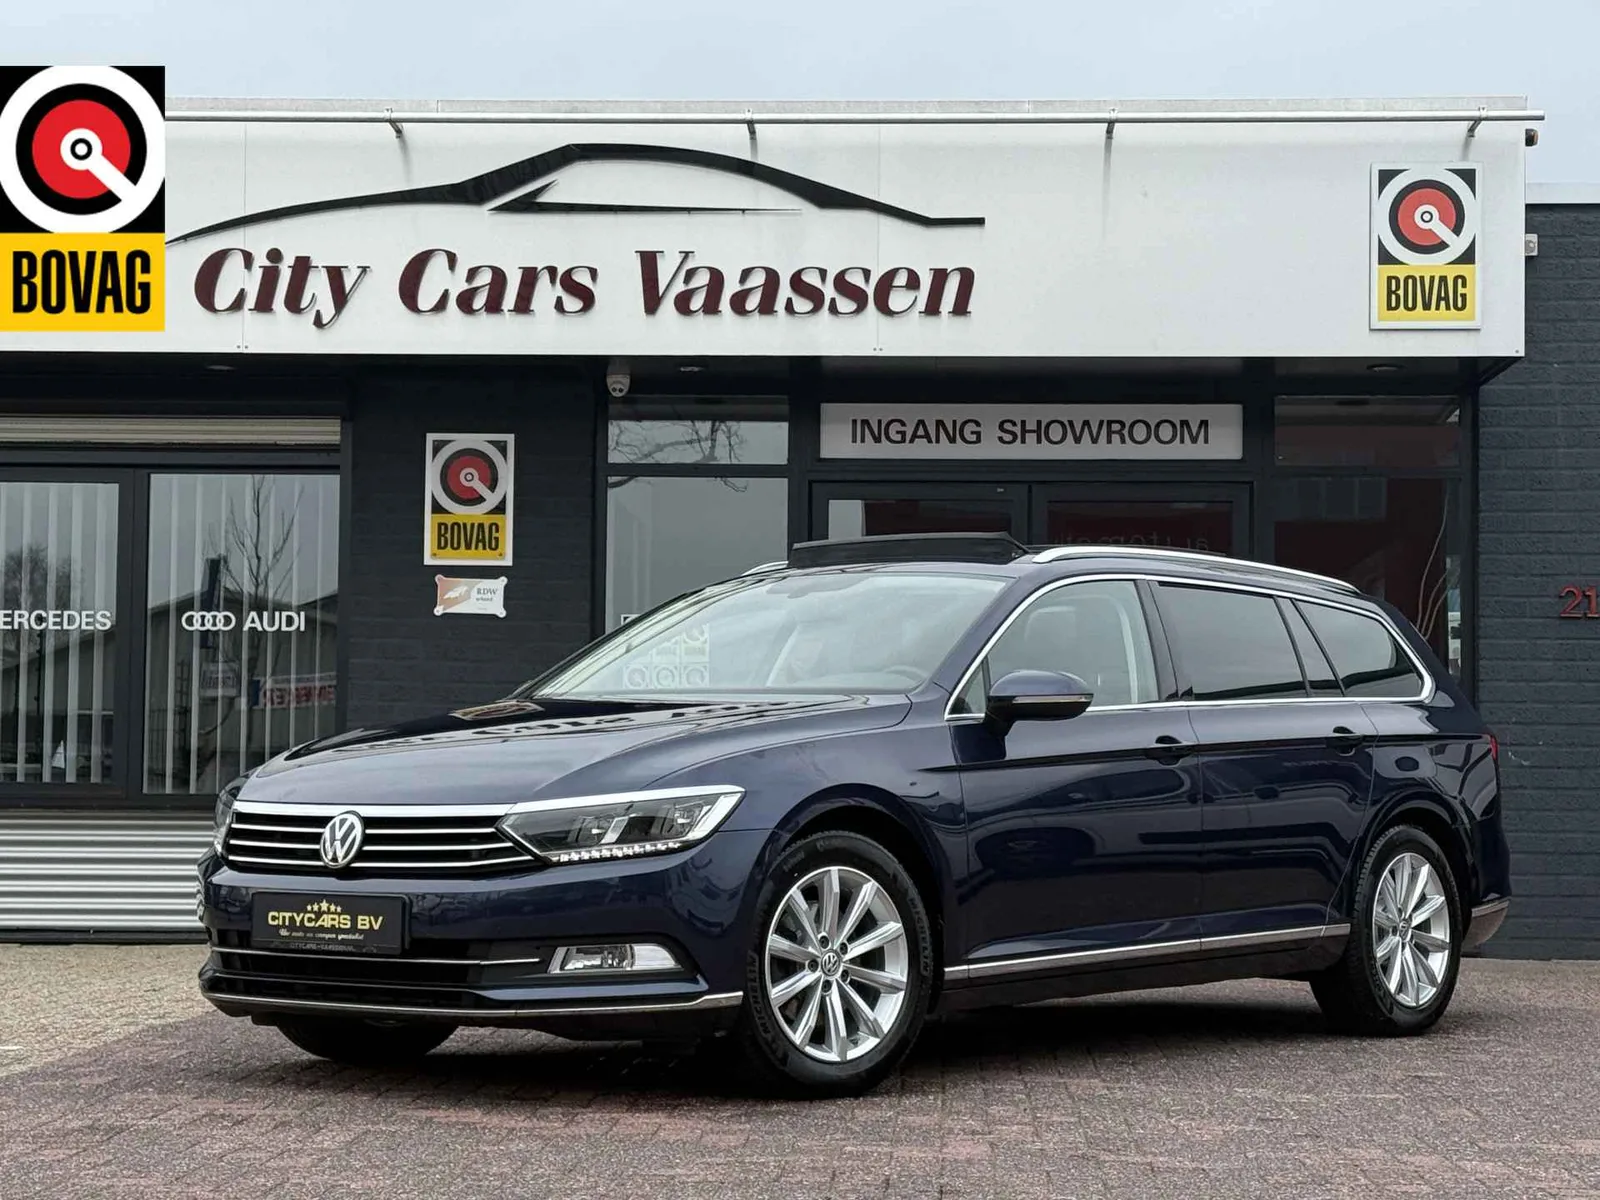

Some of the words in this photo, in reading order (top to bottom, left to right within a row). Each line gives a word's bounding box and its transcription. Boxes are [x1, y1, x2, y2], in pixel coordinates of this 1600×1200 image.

[194, 247, 371, 329] City
[398, 247, 597, 315] Cars
[634, 249, 976, 317] Vaassen
[1386, 274, 1468, 312] BOVAG
[851, 418, 982, 445] INGANG
[997, 417, 1210, 446] SHOWROOM
[437, 522, 499, 551] BOVAG
[1558, 584, 1600, 618] 21
[243, 611, 305, 632] AUDI
[267, 911, 351, 929] CITYCARS
[357, 915, 383, 930] BV
